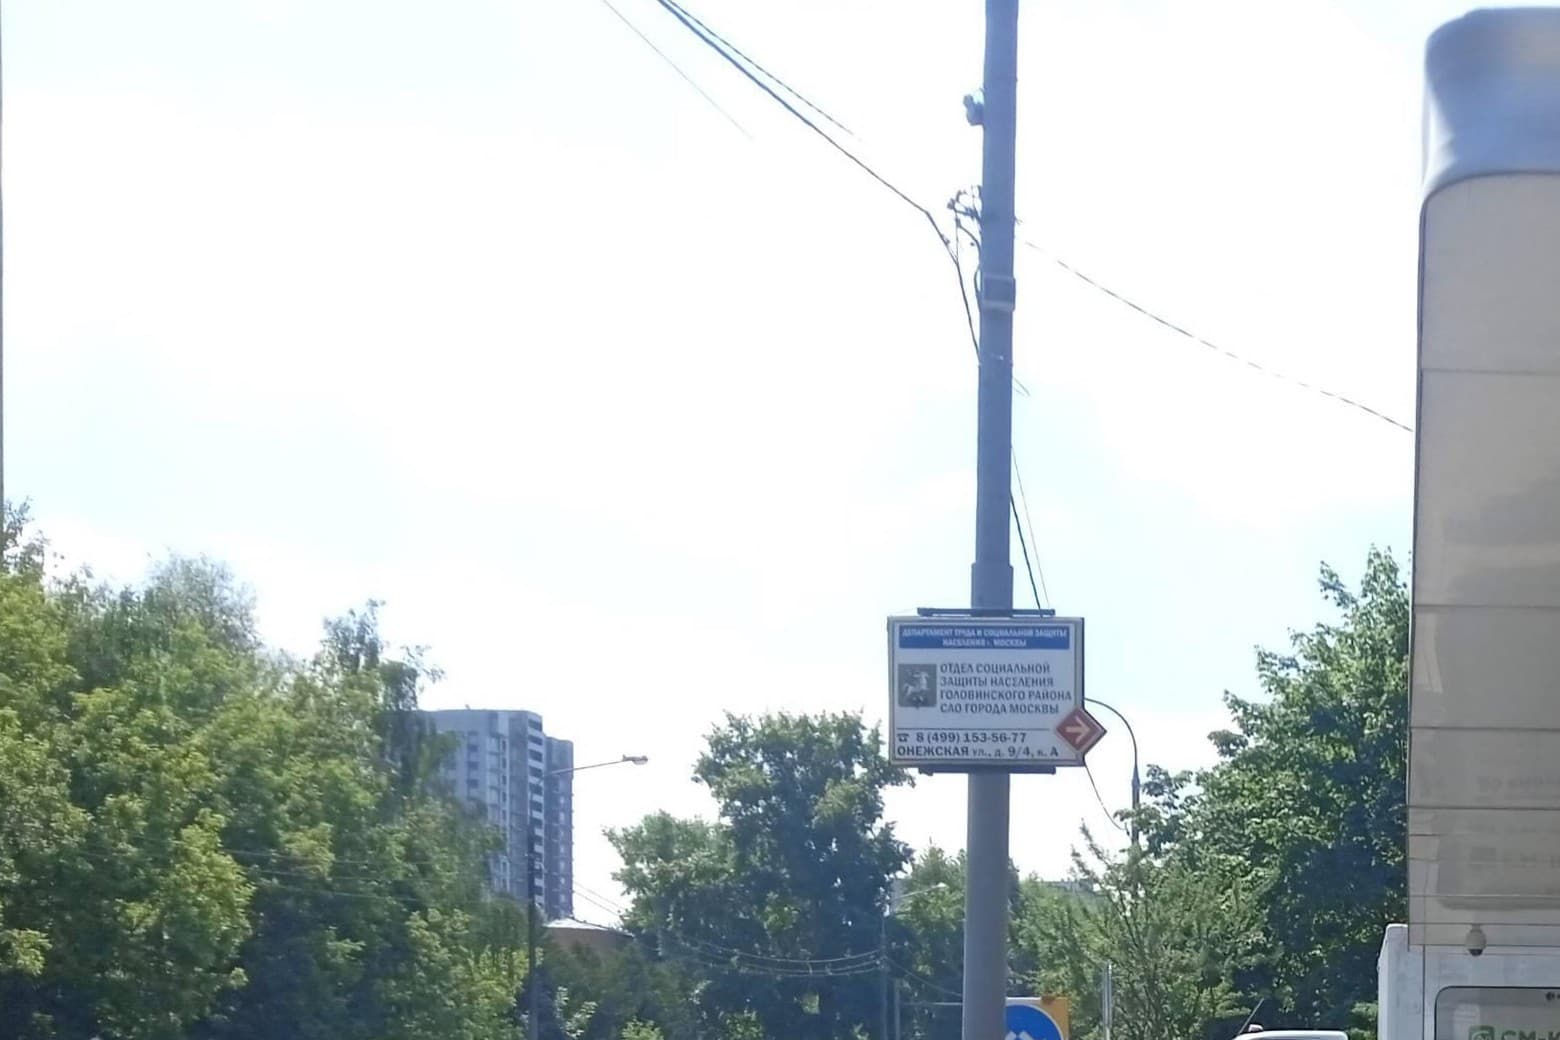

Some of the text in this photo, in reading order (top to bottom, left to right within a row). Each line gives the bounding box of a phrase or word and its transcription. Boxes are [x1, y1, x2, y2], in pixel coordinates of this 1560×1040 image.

[940, 662, 1051, 675] ОТДЕЛ СОЦИАЛЬНОЙ
[940, 676, 1055, 688] ЗАЩИТЫ НАСЕЛЕНИЯ
[940, 688, 1072, 701] ГОЛОВИНСКОГО РАЙОНА
[940, 703, 1059, 715] САО ГОРОДА МОСКВЫ
[916, 732, 1028, 744] 8 (499) 153-56-77
[897, 746, 970, 757] ОНЕЖСКАЯ
[1050, 746, 1059, 757] А
